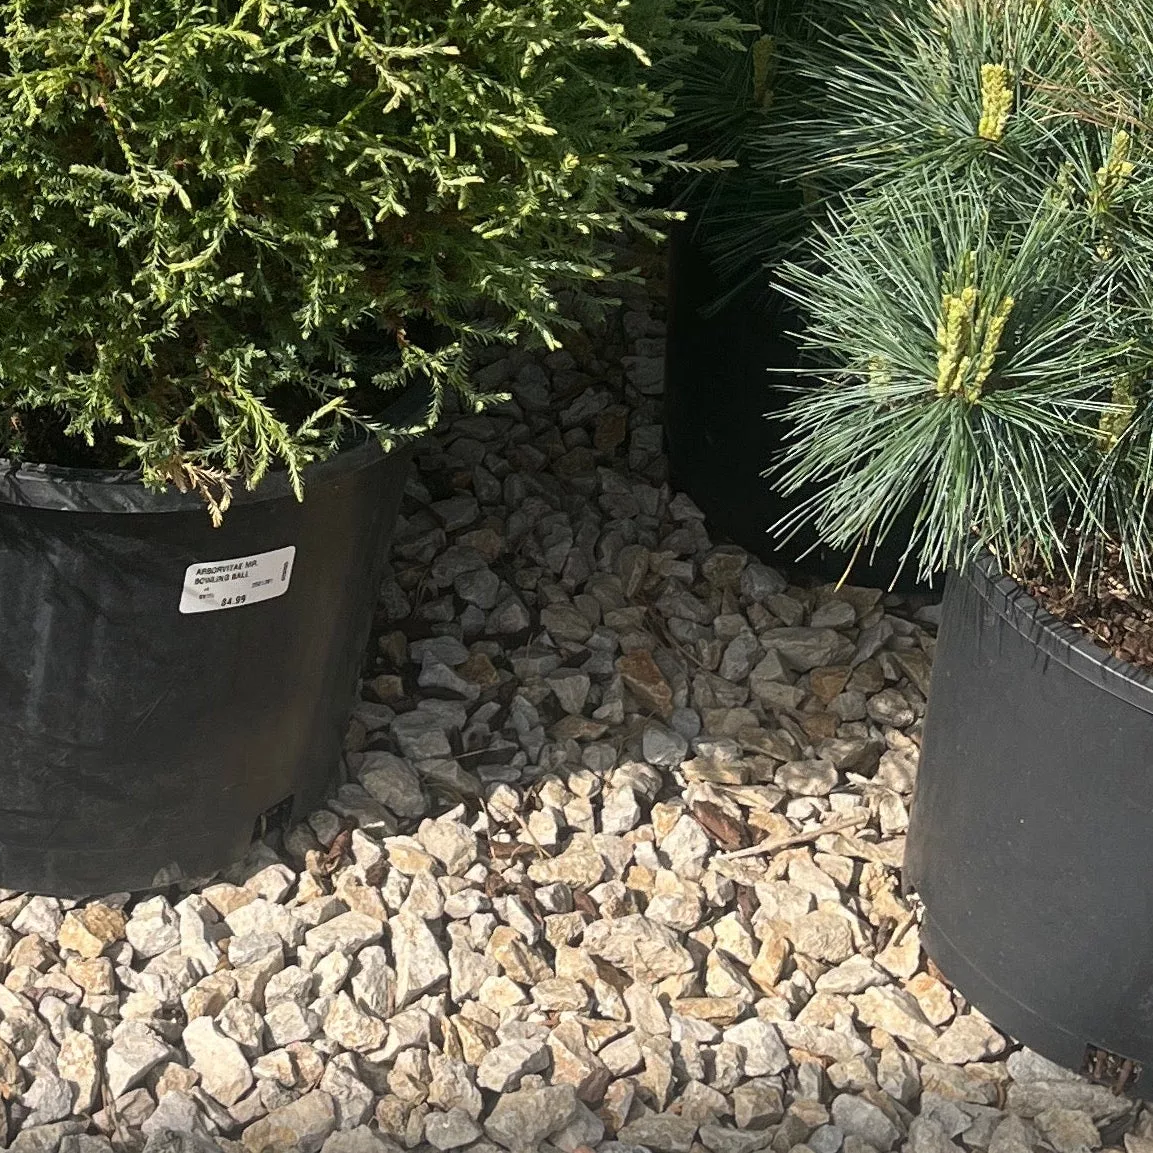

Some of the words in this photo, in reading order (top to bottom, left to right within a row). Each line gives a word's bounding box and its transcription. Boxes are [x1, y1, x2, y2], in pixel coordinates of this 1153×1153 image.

[196, 563, 243, 575] ARBORVITAE
[195, 574, 229, 585] BOWLING
[232, 571, 249, 580] BALL
